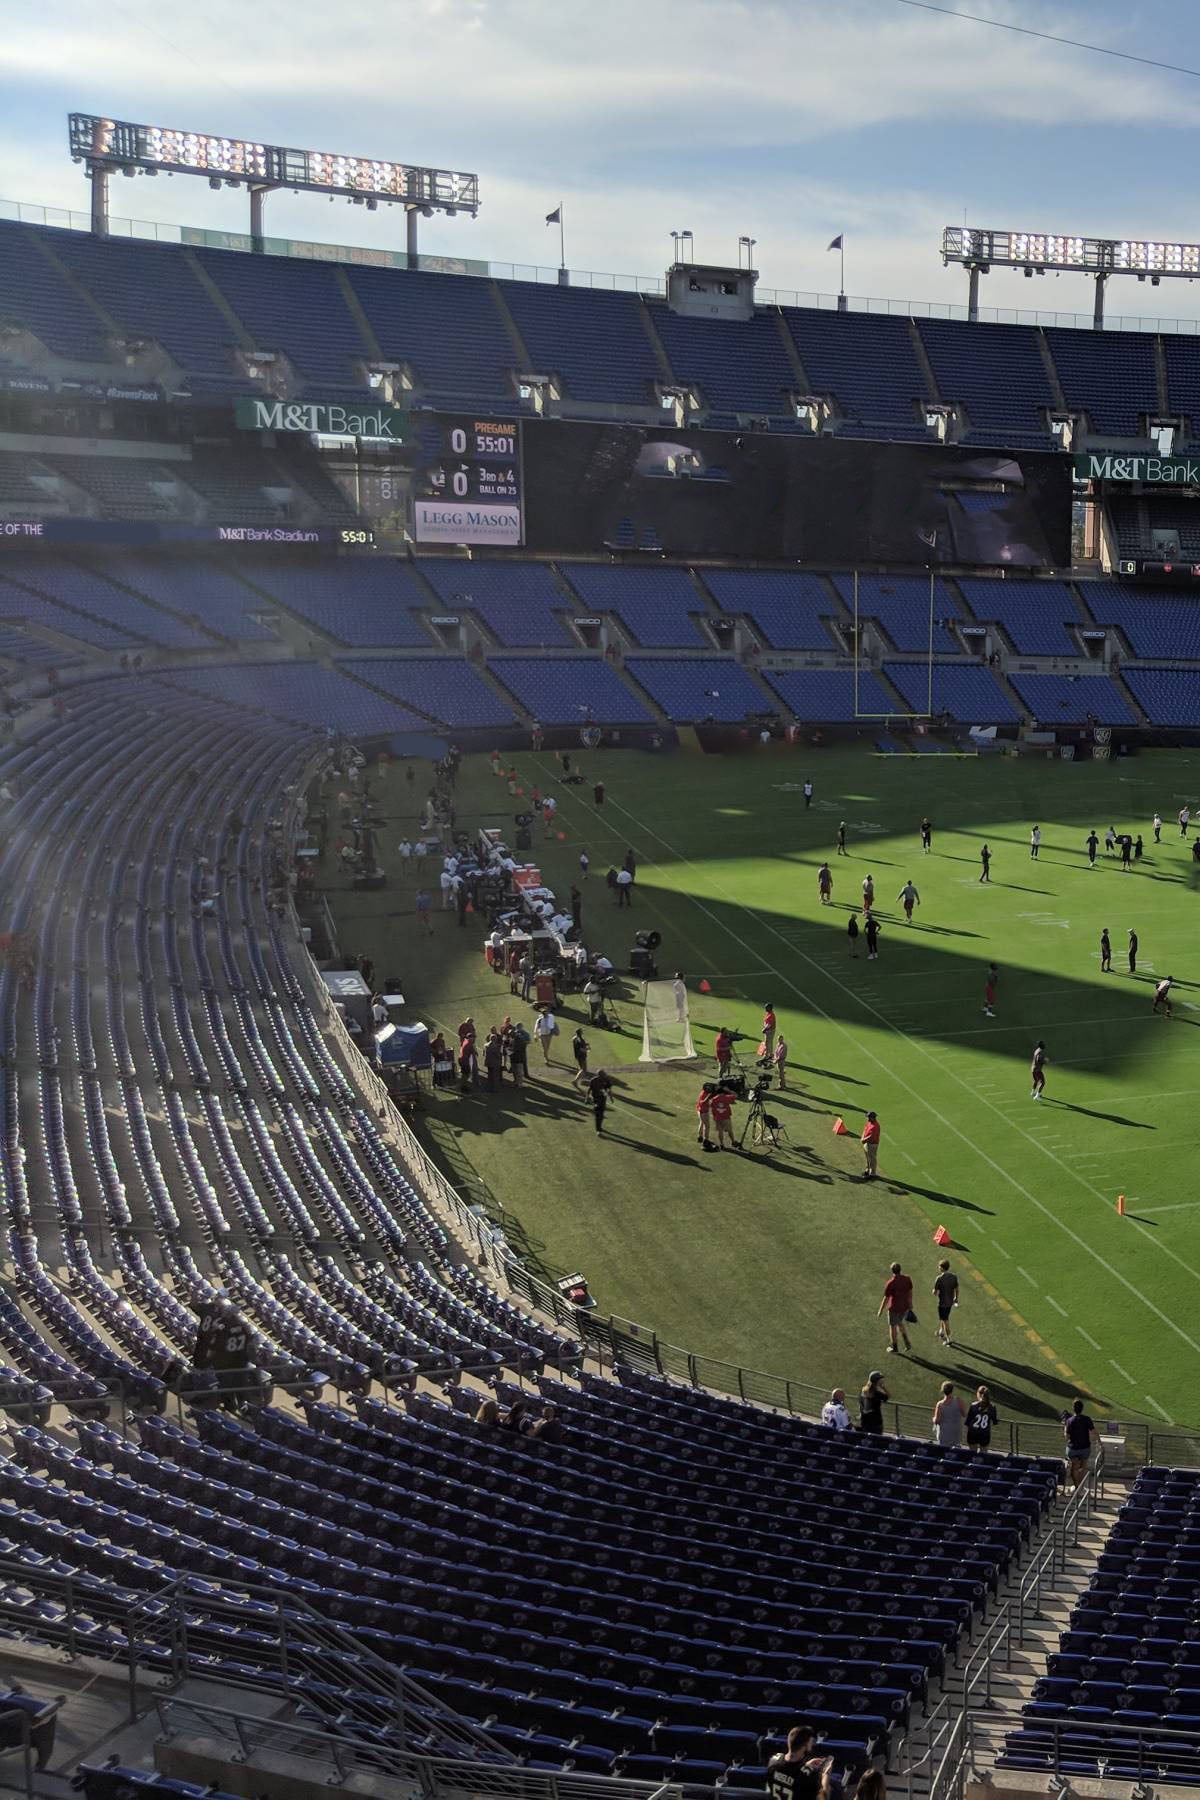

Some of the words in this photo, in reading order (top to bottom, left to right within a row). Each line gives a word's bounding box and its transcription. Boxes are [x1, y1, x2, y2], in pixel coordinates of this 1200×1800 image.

[254, 400, 326, 431] M&T
[328, 406, 394, 436] Bank
[474, 422, 517, 436] PREGAME
[452, 429, 467, 453] 0
[476, 436, 514, 454] 55:01
[479, 468, 497, 482] 3RD
[507, 470, 514, 483] 4
[1089, 455, 1145, 480] M&T
[1147, 458, 1200, 483] Bank
[453, 472, 468, 496] 0
[479, 485, 496, 494] BALL
[496, 485, 508, 495] ON
[508, 486, 517, 495] 25
[423, 510, 462, 524] LEGG
[466, 511, 518, 527] MASON
[5, 524, 20, 535] OF
[25, 524, 44, 535] THE
[219, 527, 247, 540] M&T
[247, 527, 273, 541] Bank
[274, 528, 319, 541] Stadium
[342, 530, 374, 543] 55:01
[1127, 562, 1134, 572] 0
[973, 1414, 989, 1429] 28
